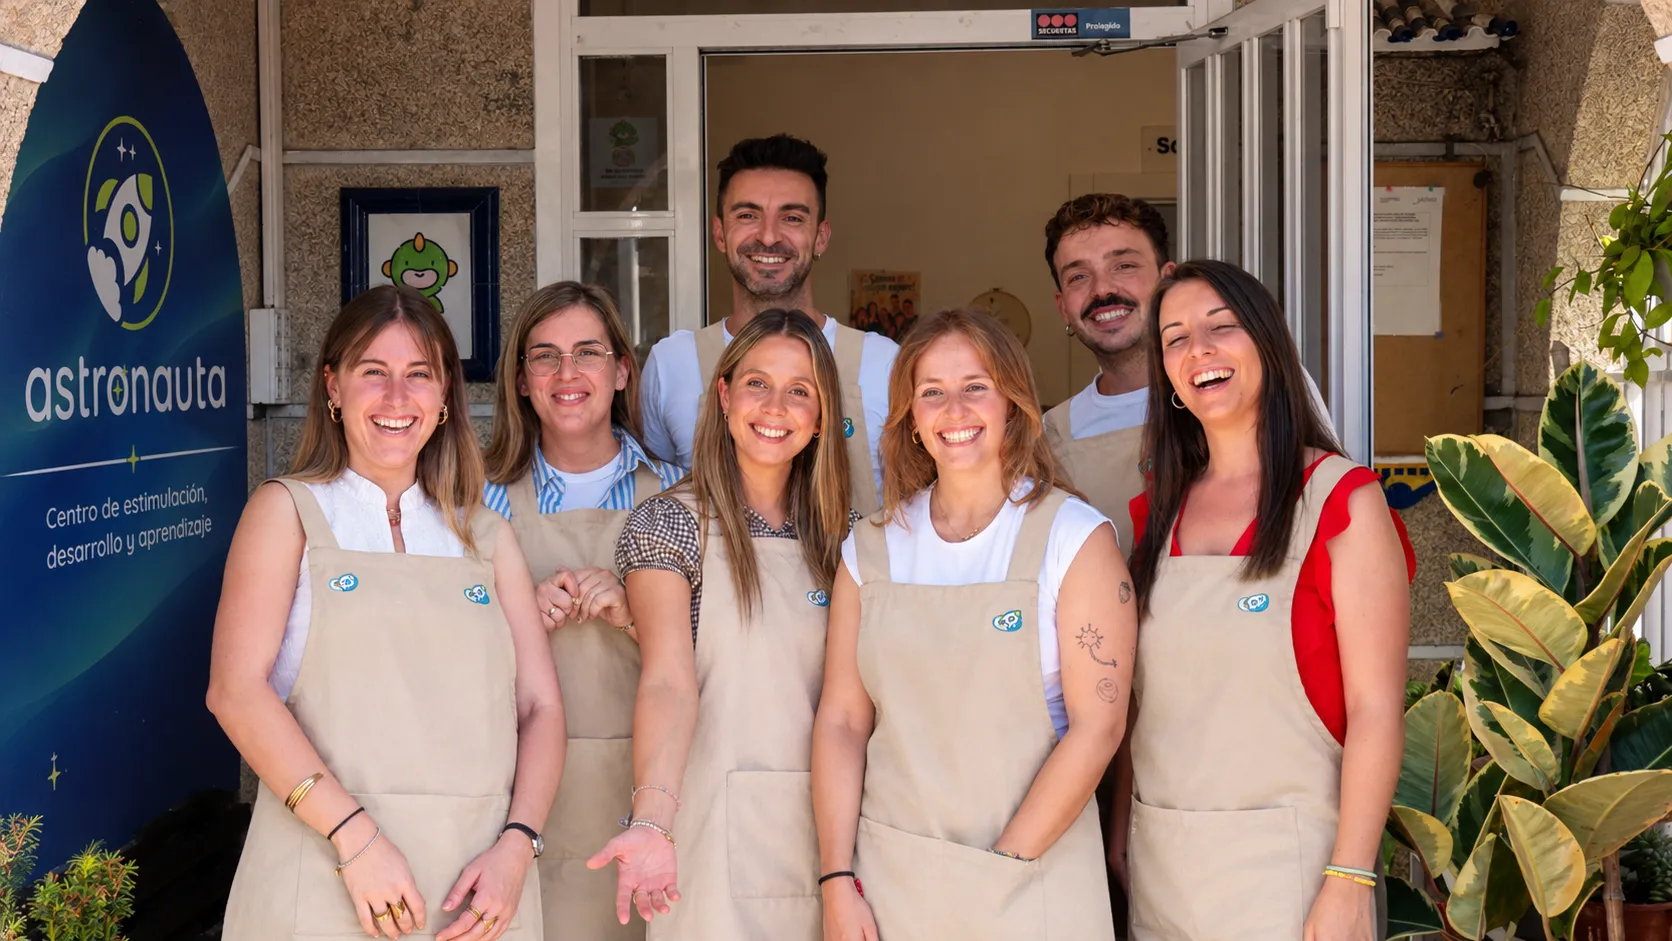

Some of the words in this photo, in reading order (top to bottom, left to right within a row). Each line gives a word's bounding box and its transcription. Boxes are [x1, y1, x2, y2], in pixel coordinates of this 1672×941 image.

[25, 355, 226, 423] astronauta
[46, 504, 98, 529] Centro
[101, 496, 120, 519] de
[123, 483, 208, 515] estimulación,
[46, 533, 123, 569] desarrollo
[126, 537, 135, 556] y
[138, 514, 212, 551] aprendizaje
